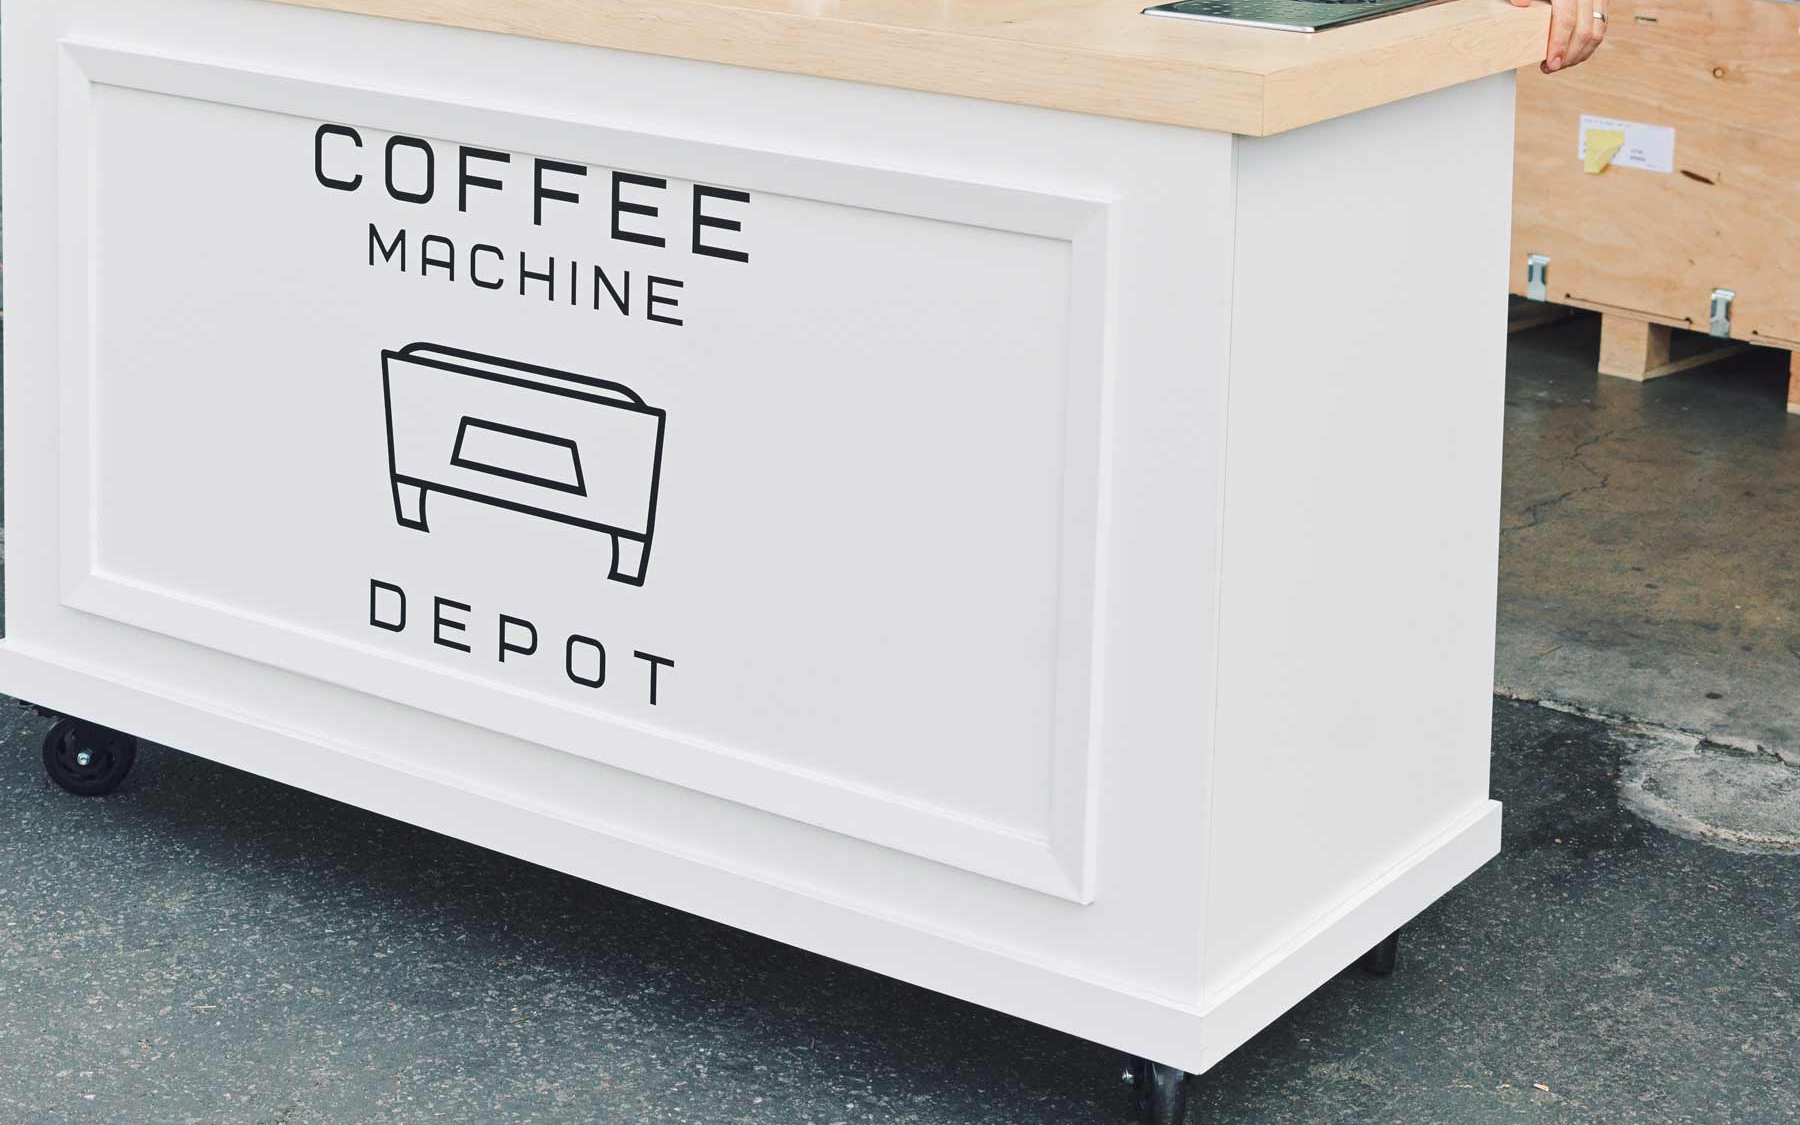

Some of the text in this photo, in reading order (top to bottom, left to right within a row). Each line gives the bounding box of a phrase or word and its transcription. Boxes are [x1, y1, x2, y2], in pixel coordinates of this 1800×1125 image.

[315, 123, 751, 264] COFFEE
[368, 223, 684, 327] MACHINE
[370, 579, 675, 706] DEPOT
